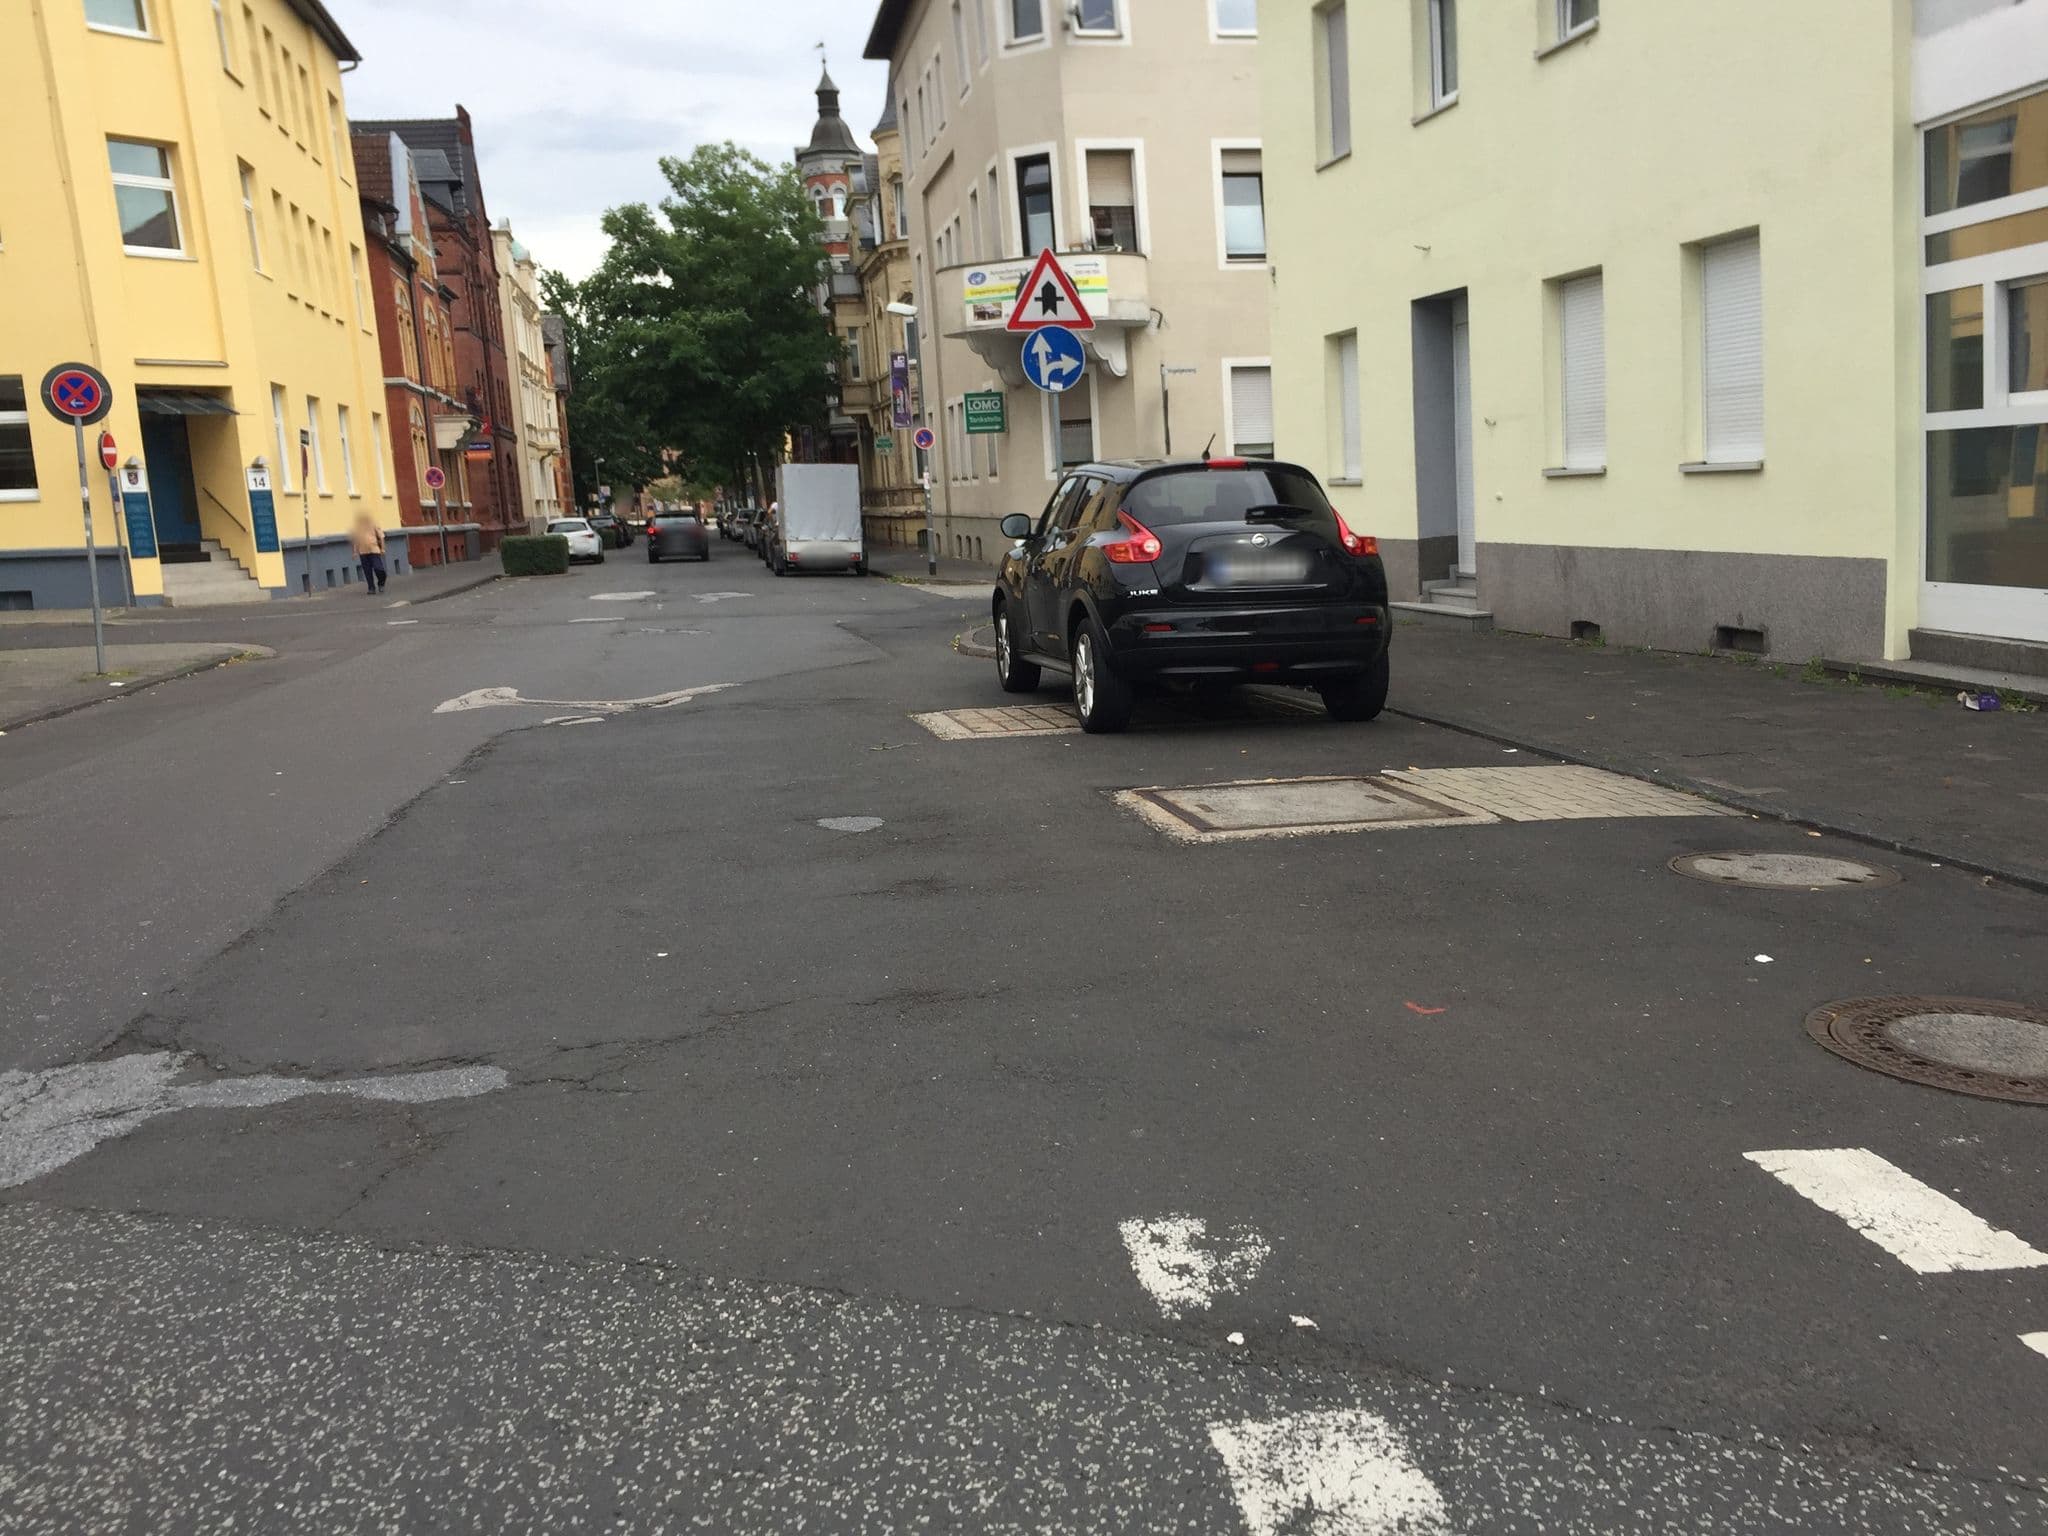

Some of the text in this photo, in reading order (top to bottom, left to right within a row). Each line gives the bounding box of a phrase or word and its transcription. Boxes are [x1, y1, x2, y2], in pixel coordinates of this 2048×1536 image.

[967, 400, 1001, 410] LOMO
[253, 476, 266, 488] 14
[1127, 589, 1158, 599] JUKE
